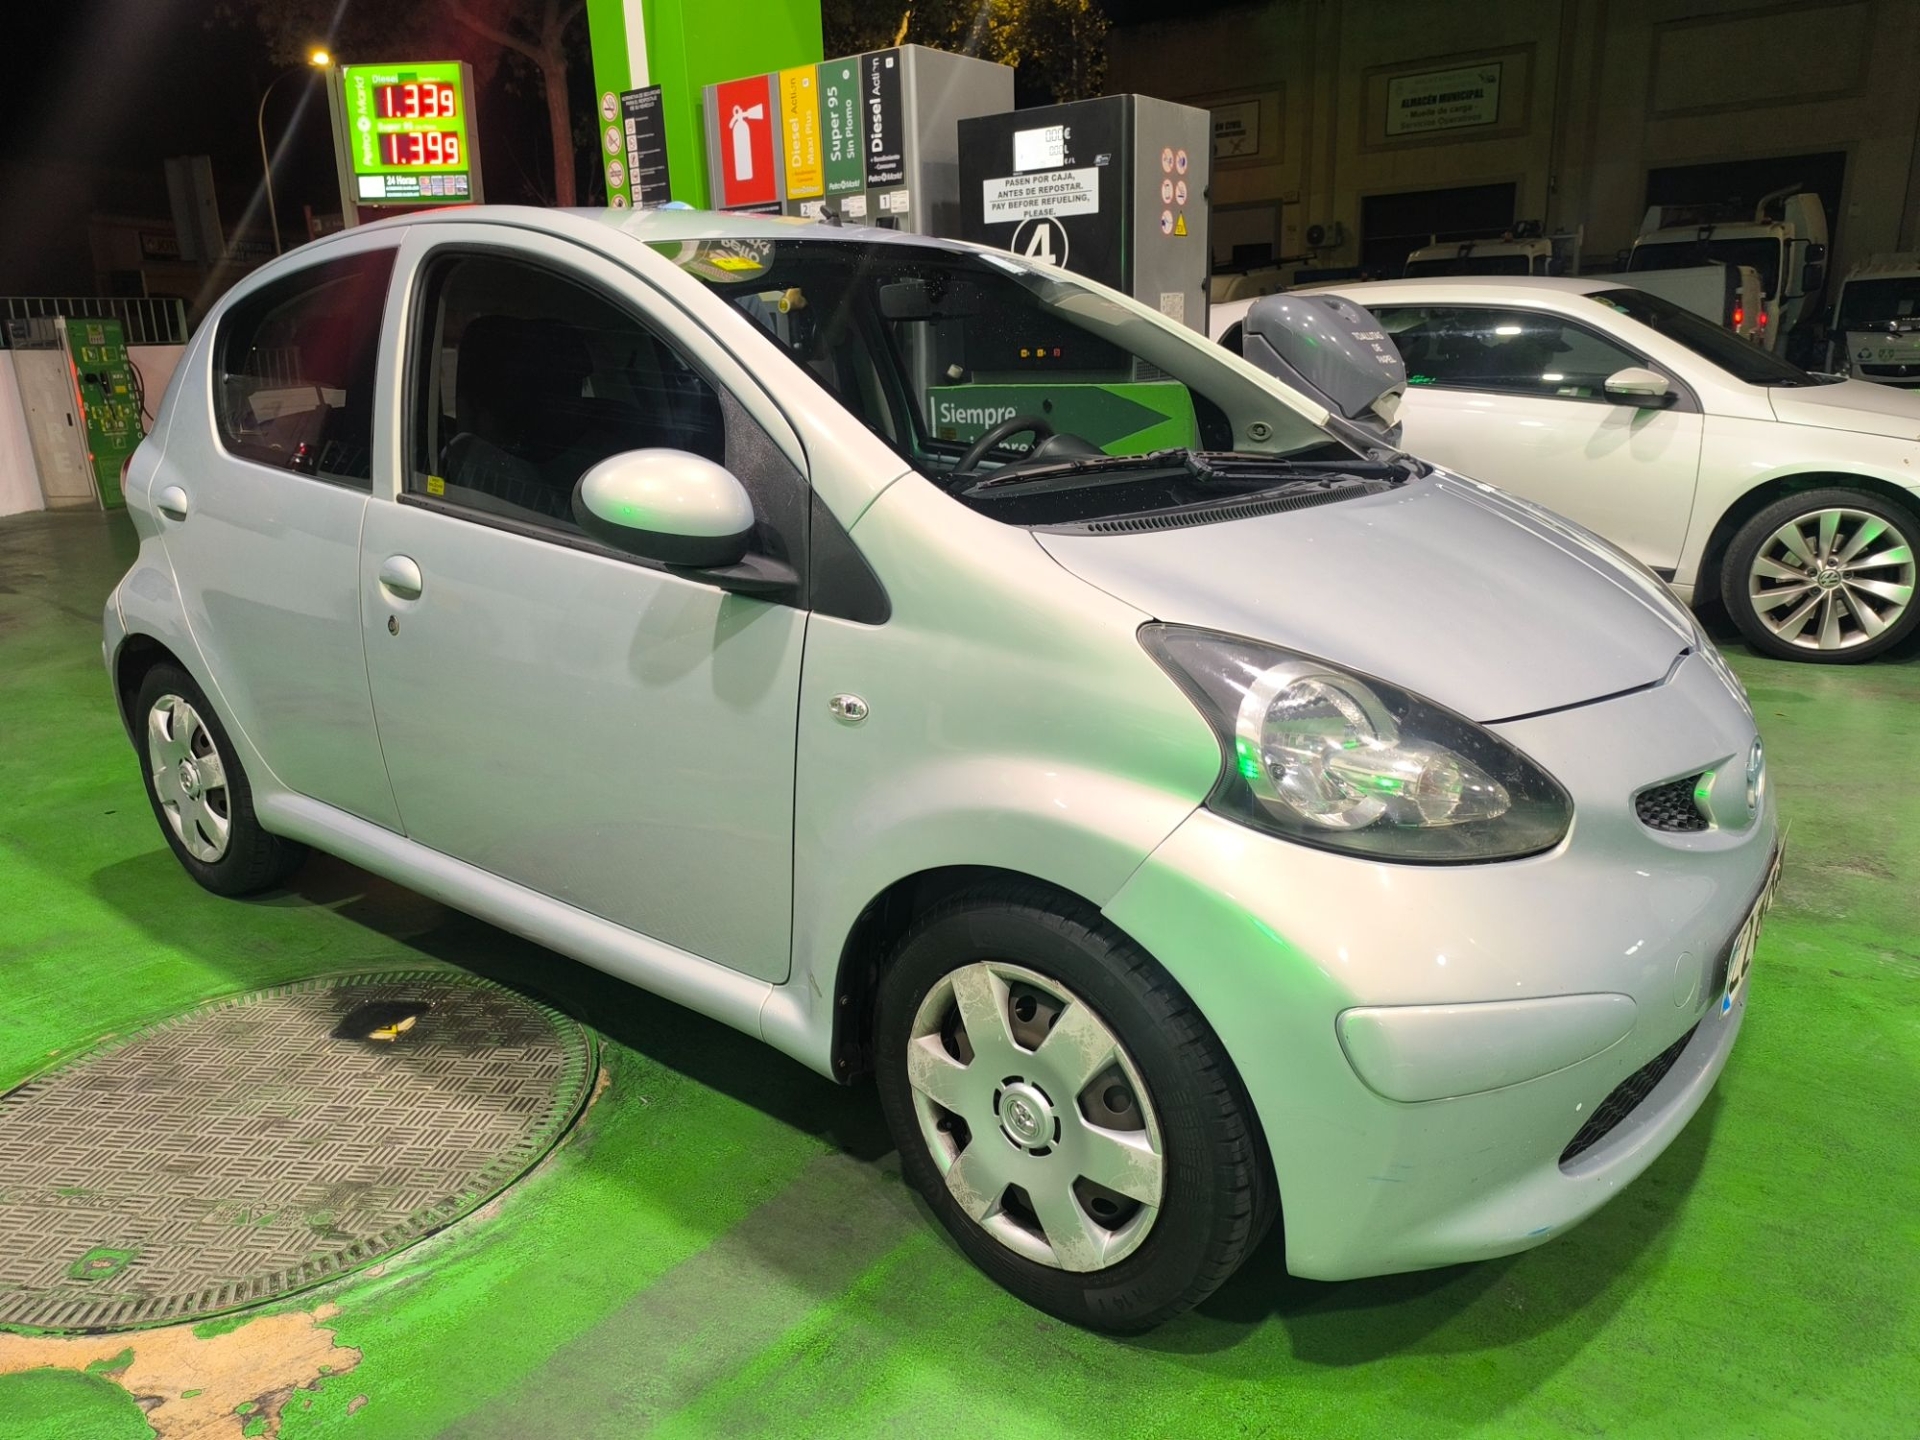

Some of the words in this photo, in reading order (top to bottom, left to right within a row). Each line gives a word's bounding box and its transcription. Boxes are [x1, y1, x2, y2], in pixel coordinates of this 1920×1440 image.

[385, 84, 454, 118] 1.339
[827, 86, 838, 108] 95
[804, 110, 813, 135] Plus
[844, 99, 854, 137] Plomo
[869, 98, 883, 153] Diesel
[391, 131, 459, 165] 1.399
[789, 118, 802, 167] Diesel
[829, 112, 843, 161] Super
[845, 140, 855, 159] Sin
[805, 138, 815, 165] Maxi
[997, 188, 1024, 199] ANTES
[1026, 187, 1037, 196] DE
[1038, 183, 1084, 194] REPOSTAR.
[1005, 178, 1031, 187] PASEN
[1032, 175, 1049, 184] POR
[1051, 172, 1075, 183] CAJA,
[991, 202, 1006, 211] PAY
[1008, 198, 1039, 209] BEFORE
[1041, 194, 1091, 206] REFUELING,
[1023, 208, 1057, 218] PLEASE.
[1024, 223, 1056, 266] 4
[77, 366, 93, 430] AIRE
[940, 402, 1017, 430] Siempre
